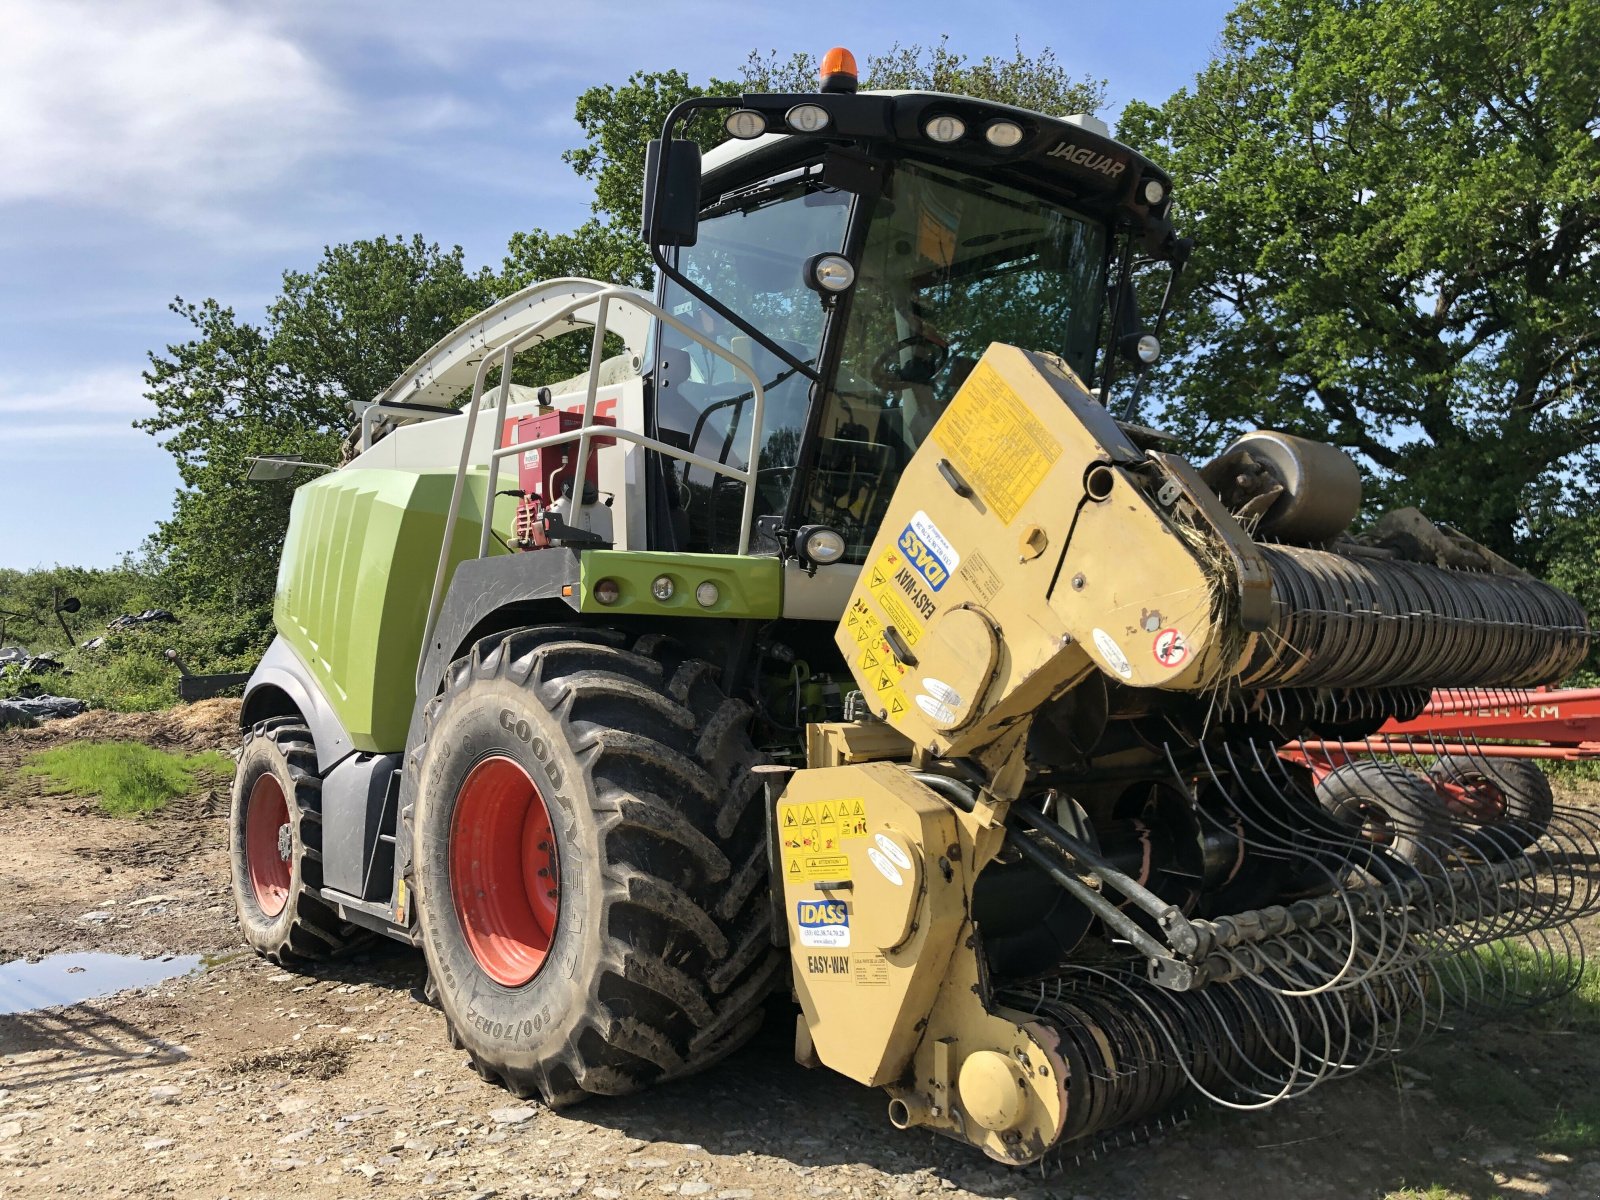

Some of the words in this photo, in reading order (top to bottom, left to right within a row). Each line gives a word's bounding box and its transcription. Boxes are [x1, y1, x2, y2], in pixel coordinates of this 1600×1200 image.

[1046, 141, 1126, 178] JAGUAR
[900, 530, 946, 587] IDASS
[894, 567, 937, 620] EASY-WAY
[1522, 704, 1560, 720] XM
[498, 707, 585, 980] GOODYEAR
[800, 904, 846, 924] IDASS
[807, 955, 849, 974] EASY-WAY
[465, 1003, 551, 1044] 800/70R32
